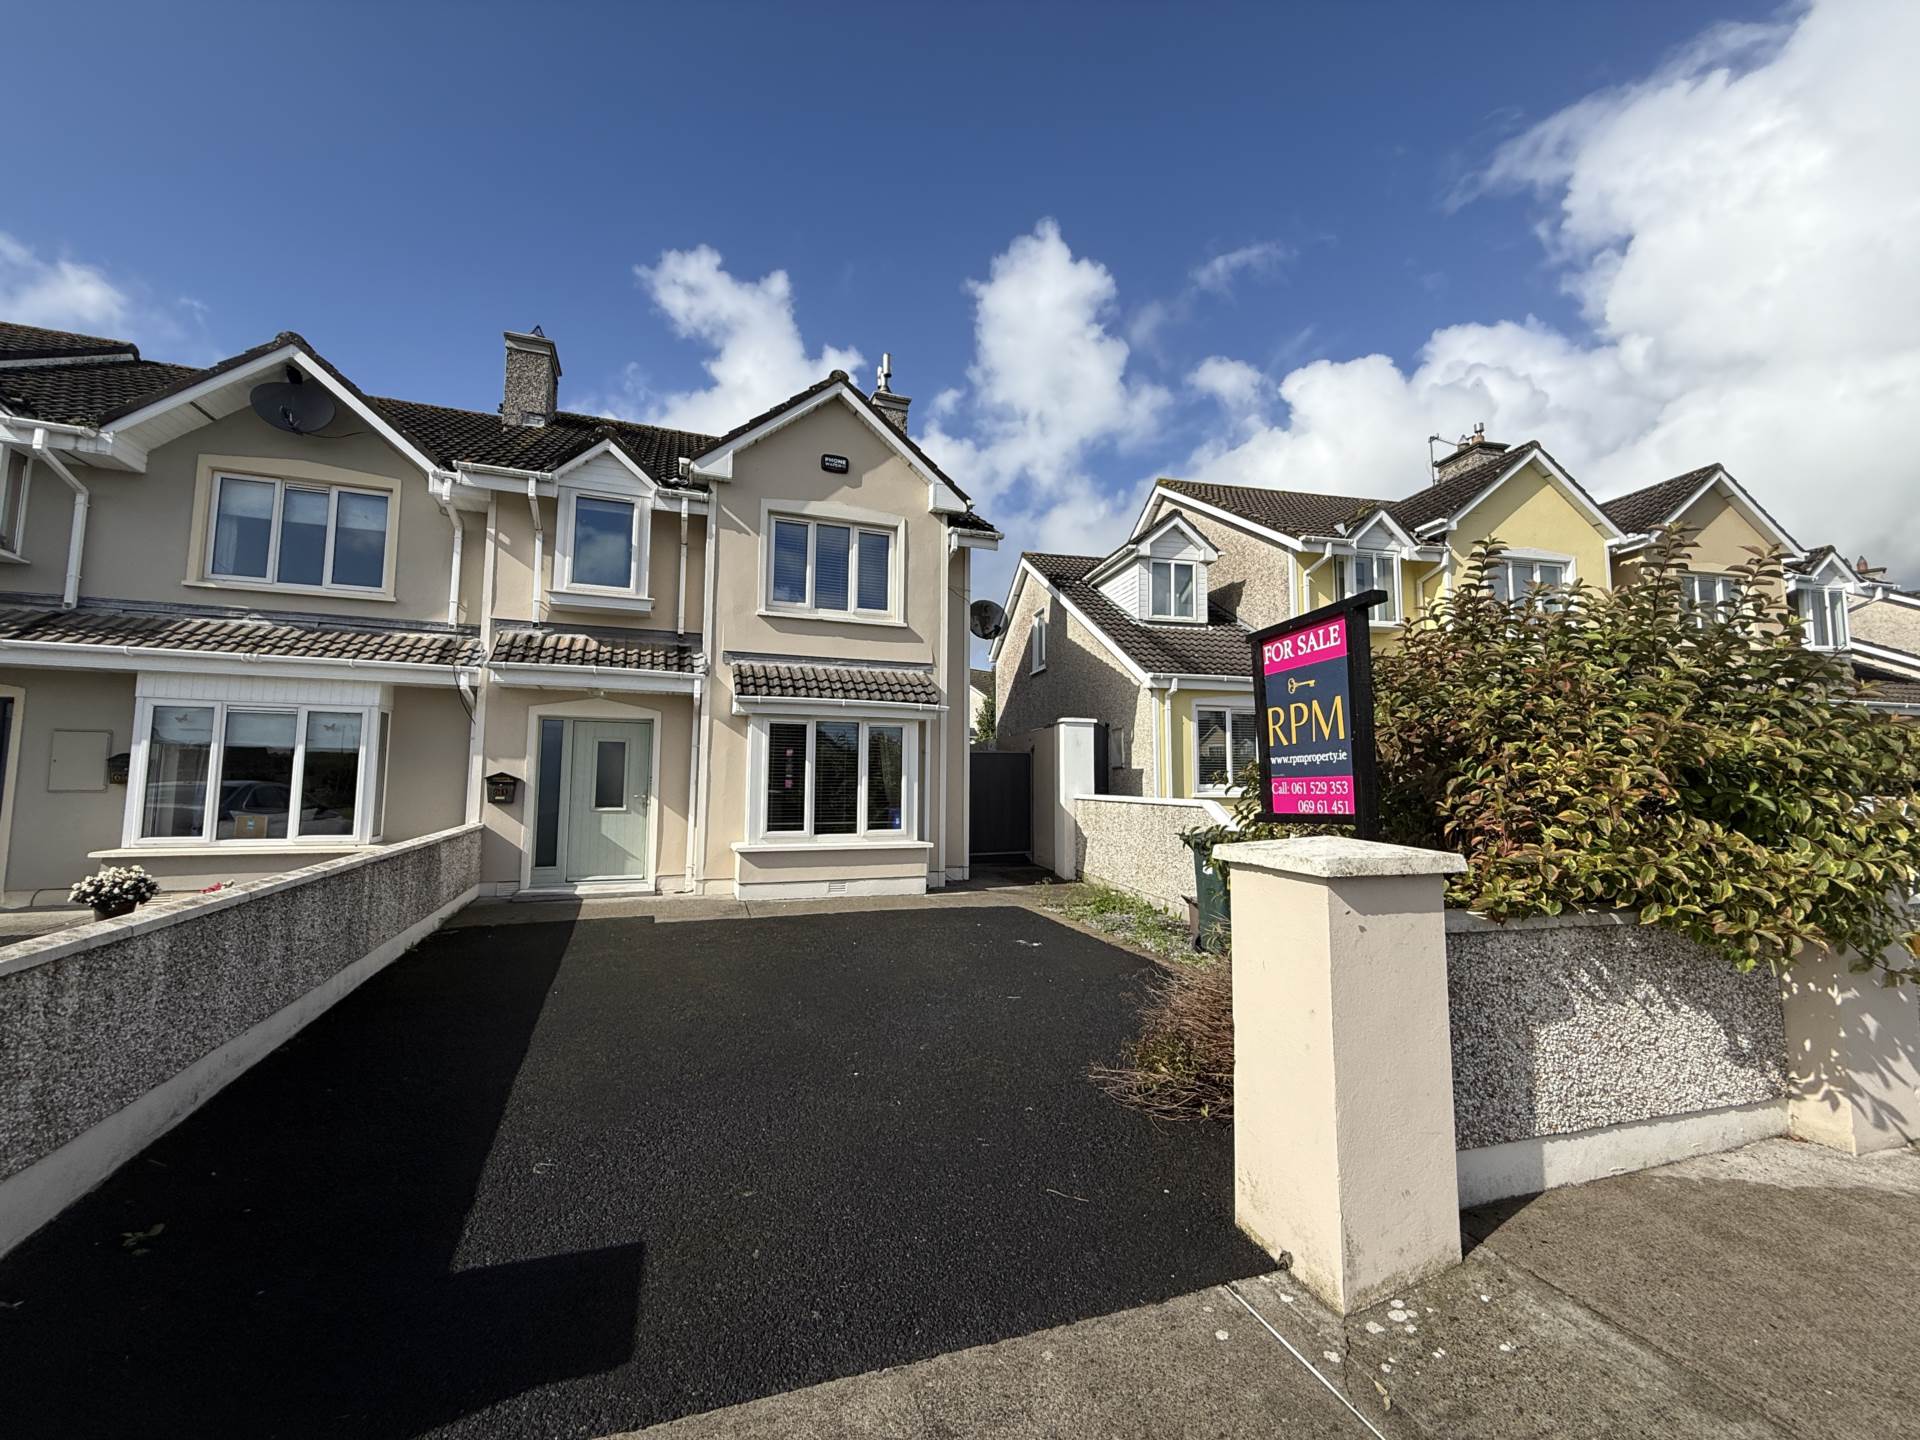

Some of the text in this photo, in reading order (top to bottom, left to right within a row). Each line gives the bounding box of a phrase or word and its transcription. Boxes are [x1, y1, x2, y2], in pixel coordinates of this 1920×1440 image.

[1263, 625, 1341, 665] FOR SALE
[1267, 696, 1345, 747] RPM
[1270, 750, 1348, 766] www.rpmproperty.ie
[1271, 781, 1348, 795] Call: 061 529 353
[1297, 801, 1349, 814] 069 61 451
